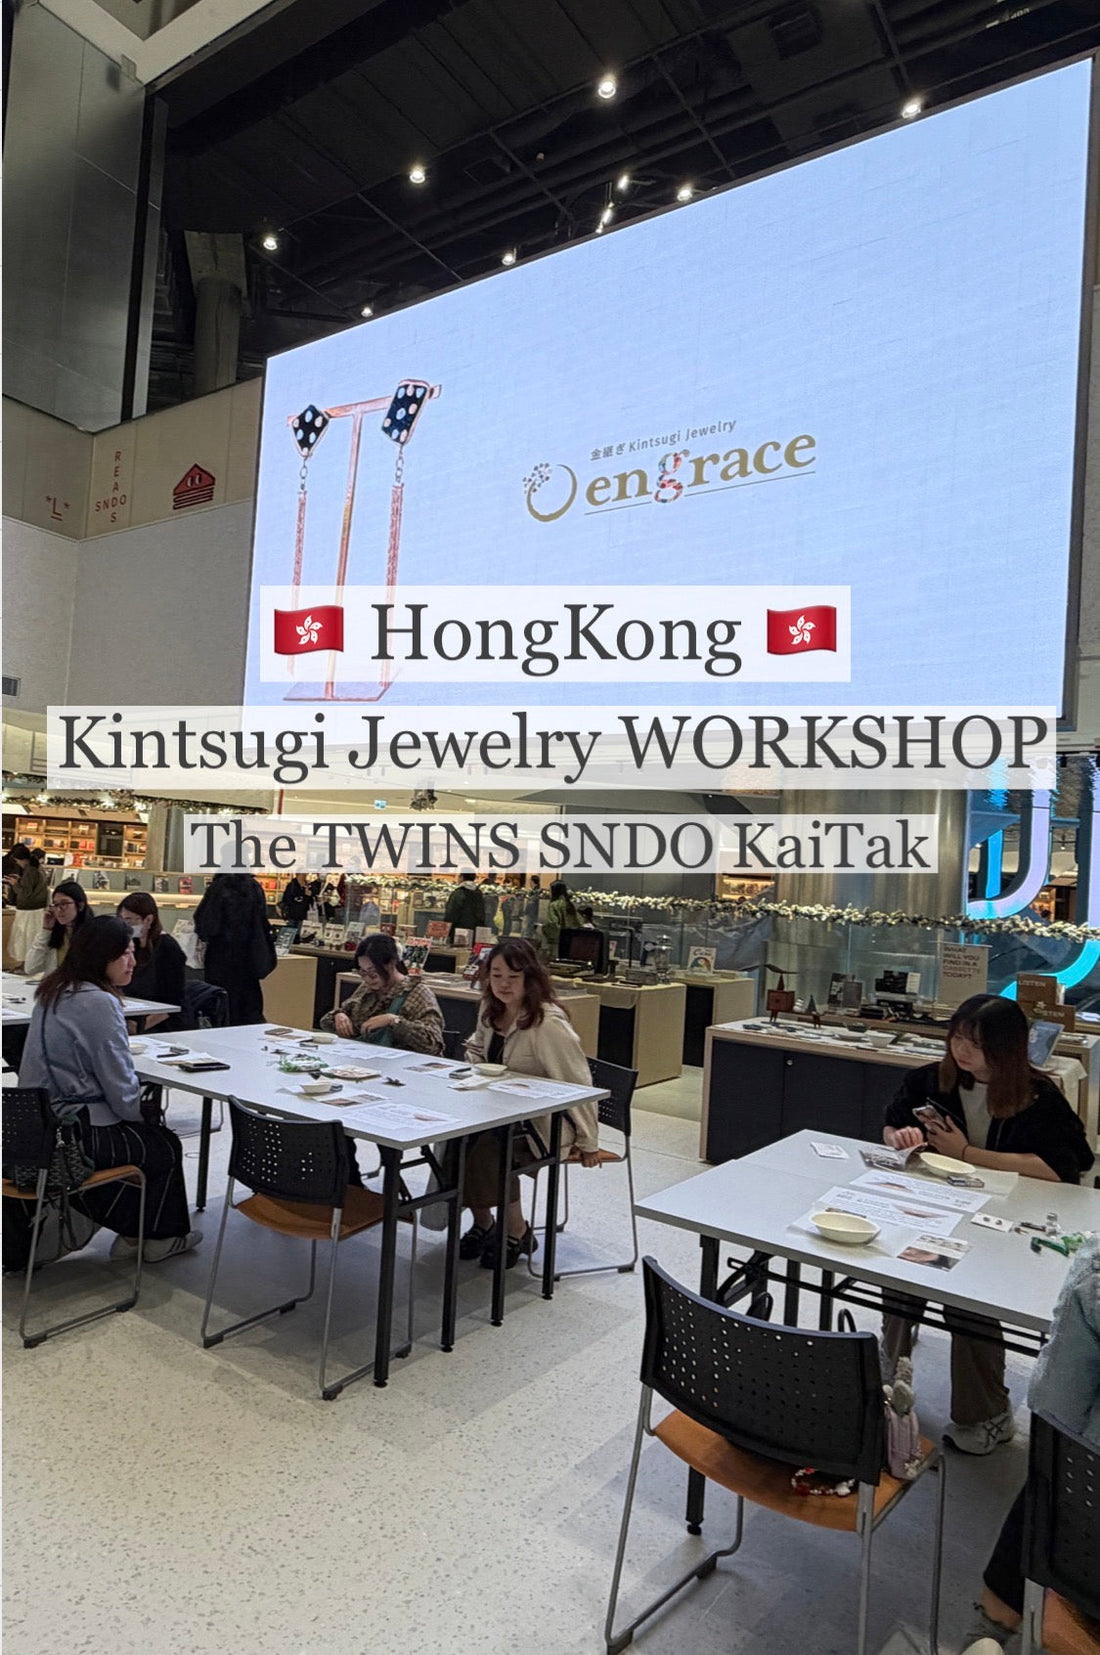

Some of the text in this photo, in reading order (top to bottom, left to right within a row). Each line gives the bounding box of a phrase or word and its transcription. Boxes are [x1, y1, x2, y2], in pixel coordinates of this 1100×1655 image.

[629, 431, 681, 453] Kintsugi
[685, 420, 736, 441] Jewelry
[585, 434, 816, 503] engrace
[94, 494, 127, 512] SNDO
[1018, 979, 1046, 987] LISTEN
